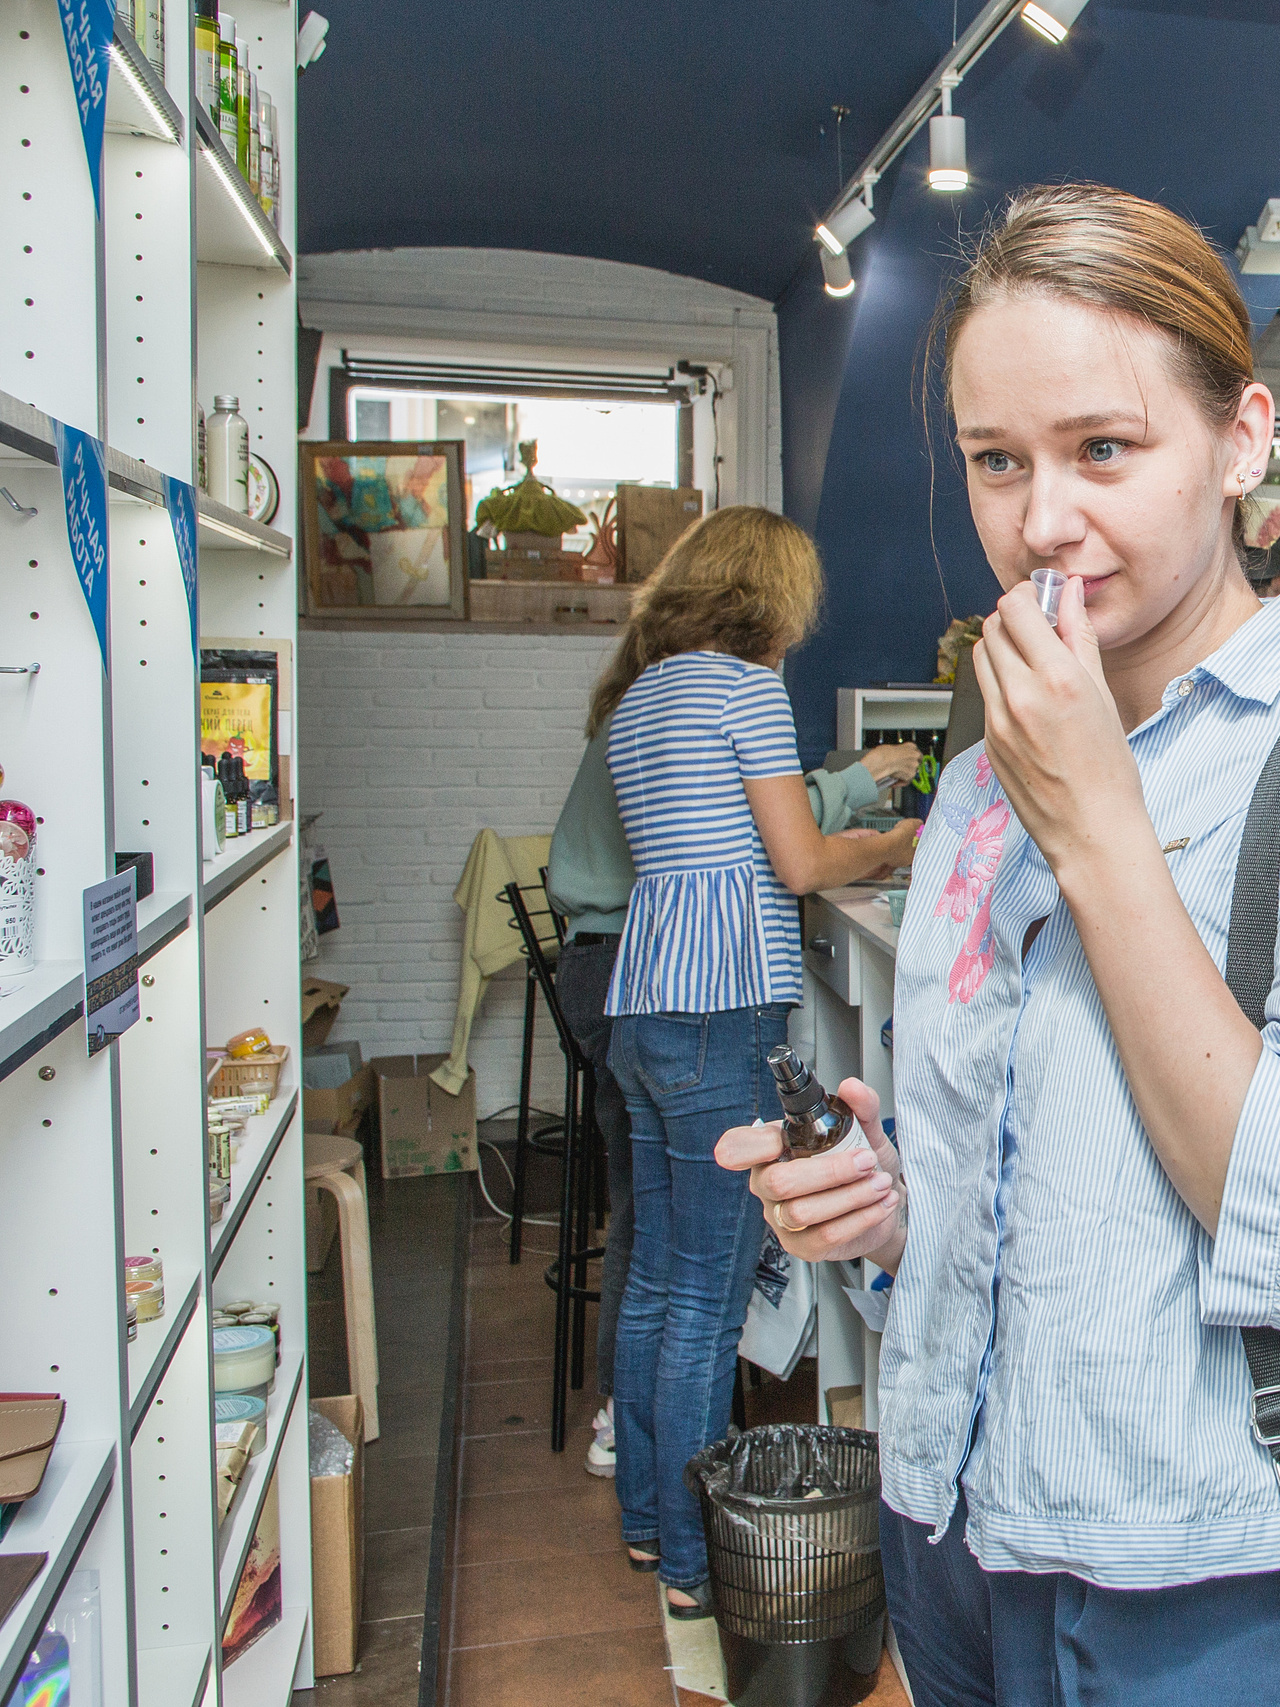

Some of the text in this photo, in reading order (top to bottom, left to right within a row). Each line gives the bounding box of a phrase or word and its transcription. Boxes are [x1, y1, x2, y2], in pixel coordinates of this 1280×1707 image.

[79, 0, 104, 110] ЧНАЯ
[67, 477, 95, 598] РАБОТА
[73, 441, 105, 574] РУЧНАЯ
[200, 716, 254, 734] ЧИЙ ПЕРЕЦ
